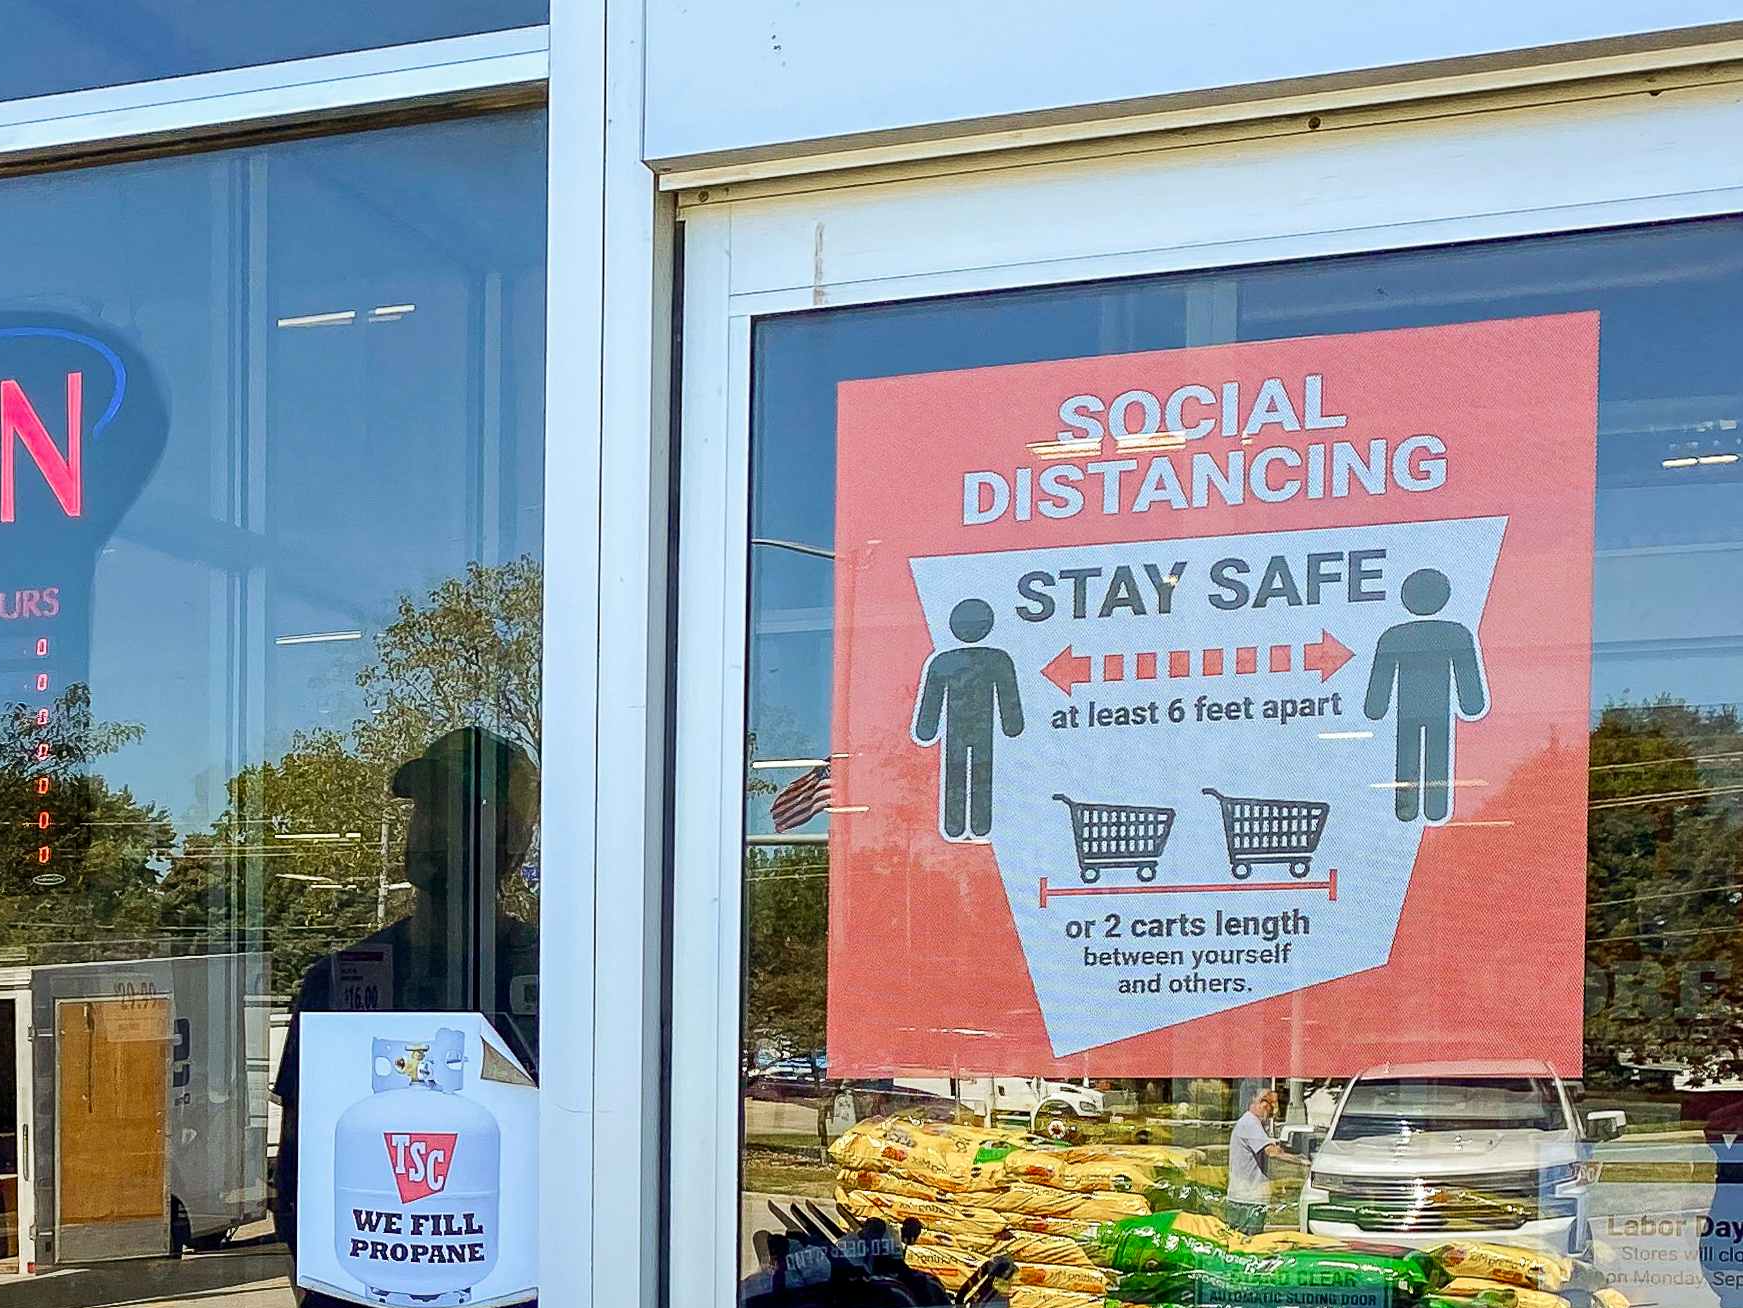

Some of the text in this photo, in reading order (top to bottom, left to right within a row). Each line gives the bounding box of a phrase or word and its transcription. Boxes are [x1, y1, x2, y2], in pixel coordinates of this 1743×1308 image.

[1057, 374, 1347, 442] SOCIAL
[962, 434, 1449, 525] DISTANCING
[1016, 549, 1388, 622] STAY SAFE
[1051, 692, 1343, 730] at least 6 feet apart
[1065, 908, 1311, 942] or 2 carts length
[1083, 942, 1292, 969] between yourself
[1118, 973, 1253, 995] and others.
[391, 1134, 446, 1192] TSC
[353, 1209, 485, 1237] WE FILL
[1607, 1215, 1743, 1245] Labor Day
[350, 1237, 485, 1264] PROPANE
[1622, 1246, 1678, 1262] Stores
[1209, 1289, 1377, 1307] AUTOMATIC SLIDING DOOR
